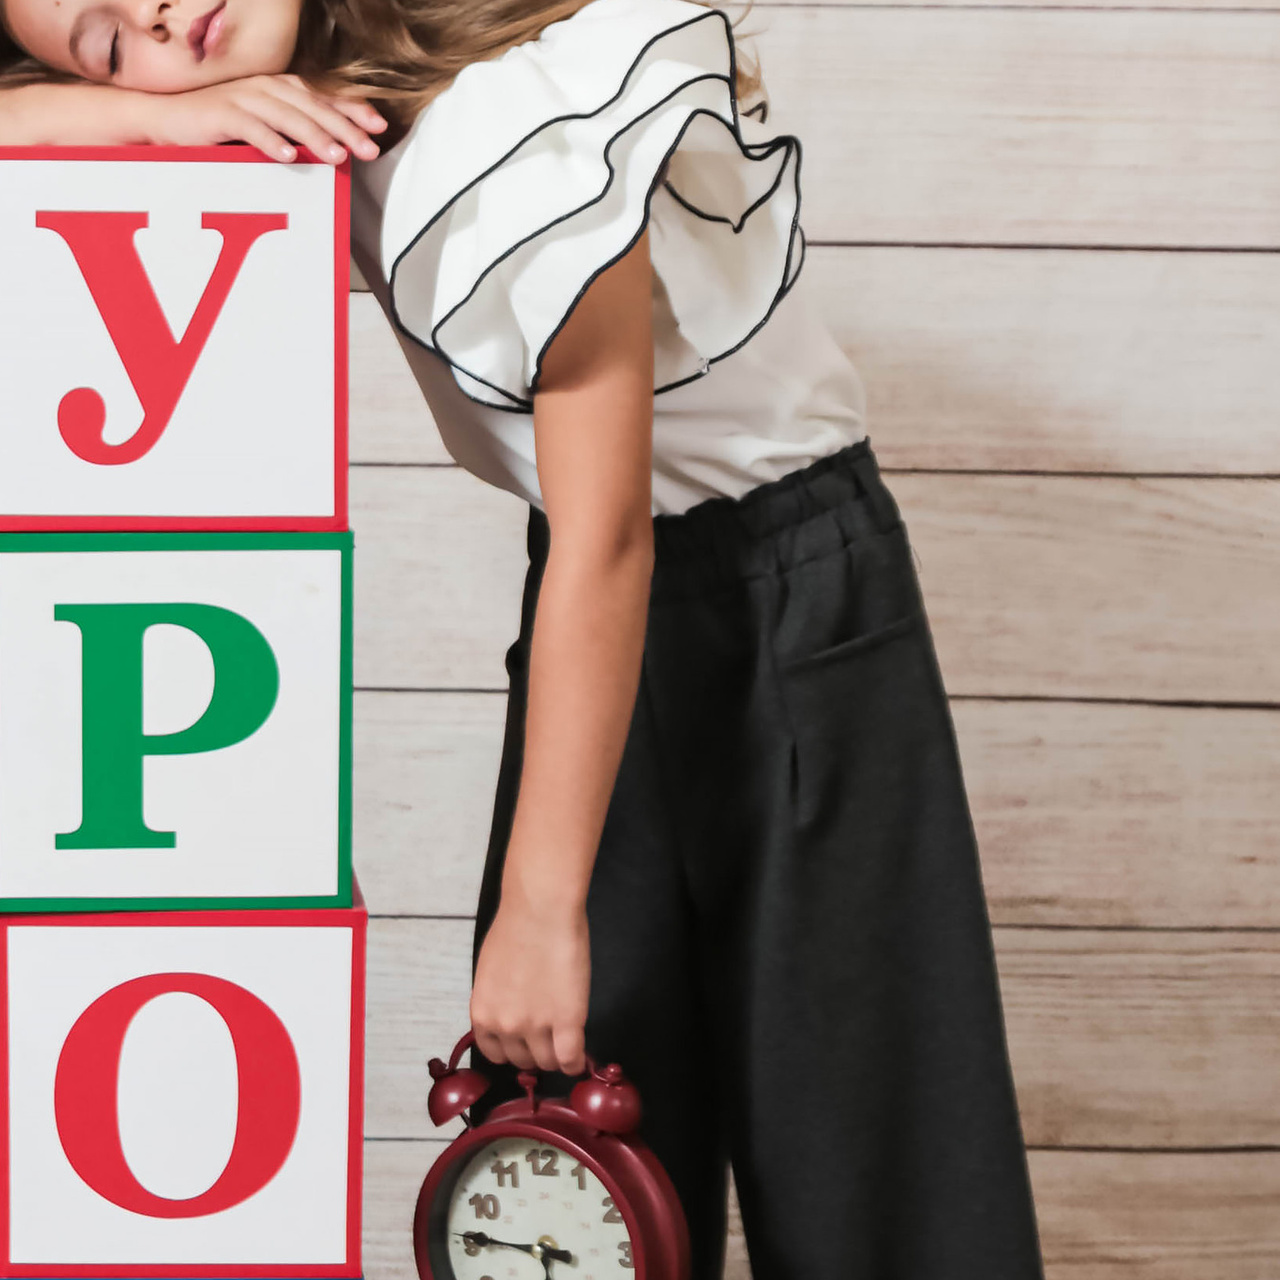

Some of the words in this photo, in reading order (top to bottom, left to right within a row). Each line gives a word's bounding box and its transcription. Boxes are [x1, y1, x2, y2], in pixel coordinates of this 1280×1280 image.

[490, 1159, 519, 1189] 11
[525, 1148, 560, 1177] 12
[571, 1161, 587, 1191] 1
[469, 1192, 501, 1220] 10
[602, 1196, 624, 1224] 2
[617, 1241, 635, 1269] 3
